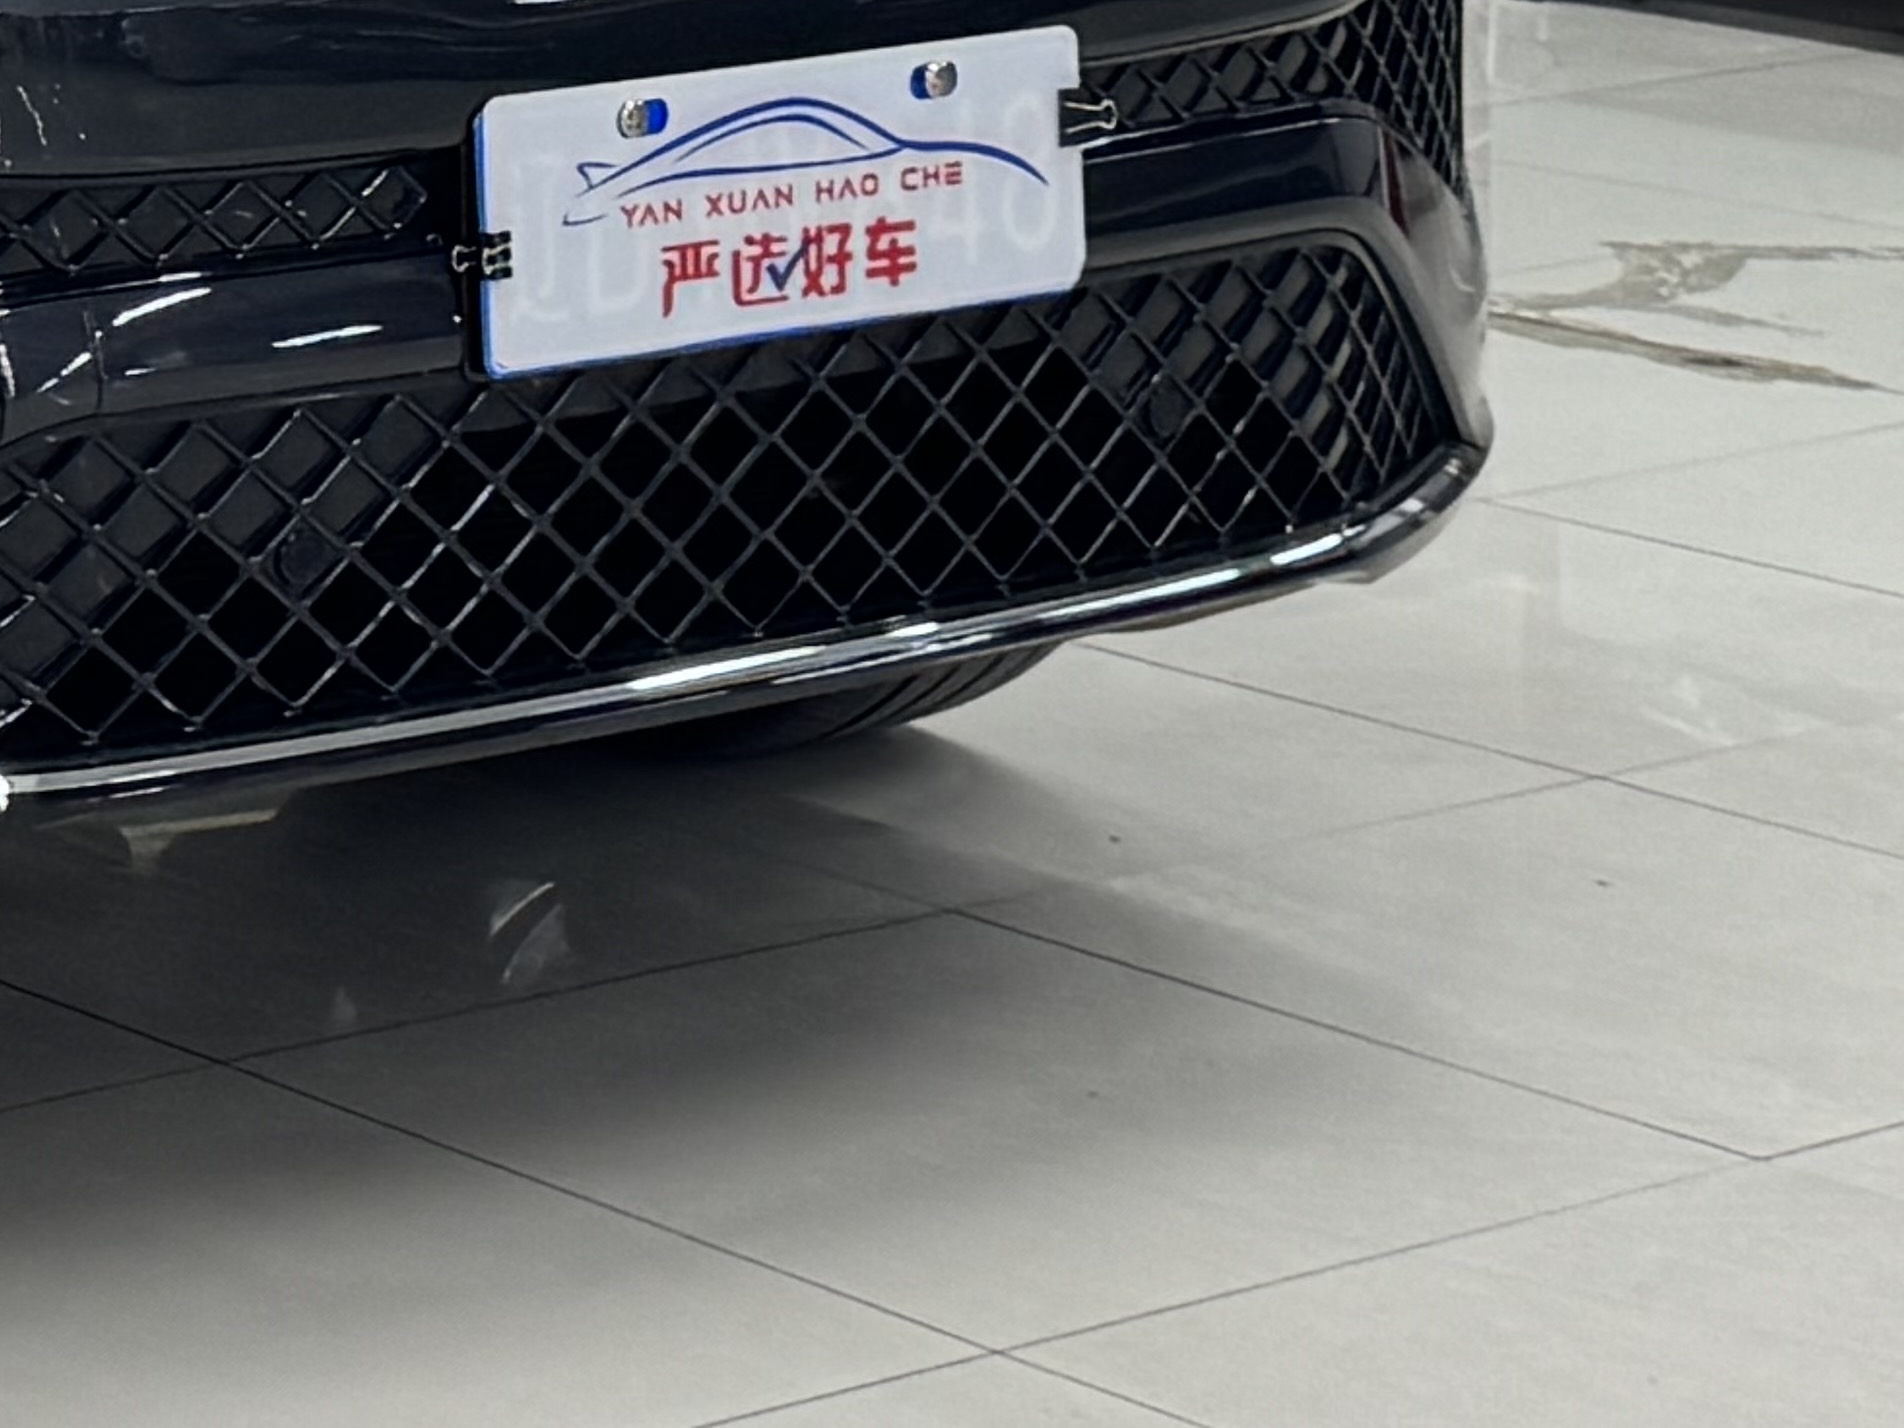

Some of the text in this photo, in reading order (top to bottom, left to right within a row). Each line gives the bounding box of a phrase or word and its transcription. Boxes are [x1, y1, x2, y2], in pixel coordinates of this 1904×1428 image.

[619, 160, 965, 230] YAN XUAN HAO CHE
[660, 215, 918, 319] 严选好车
